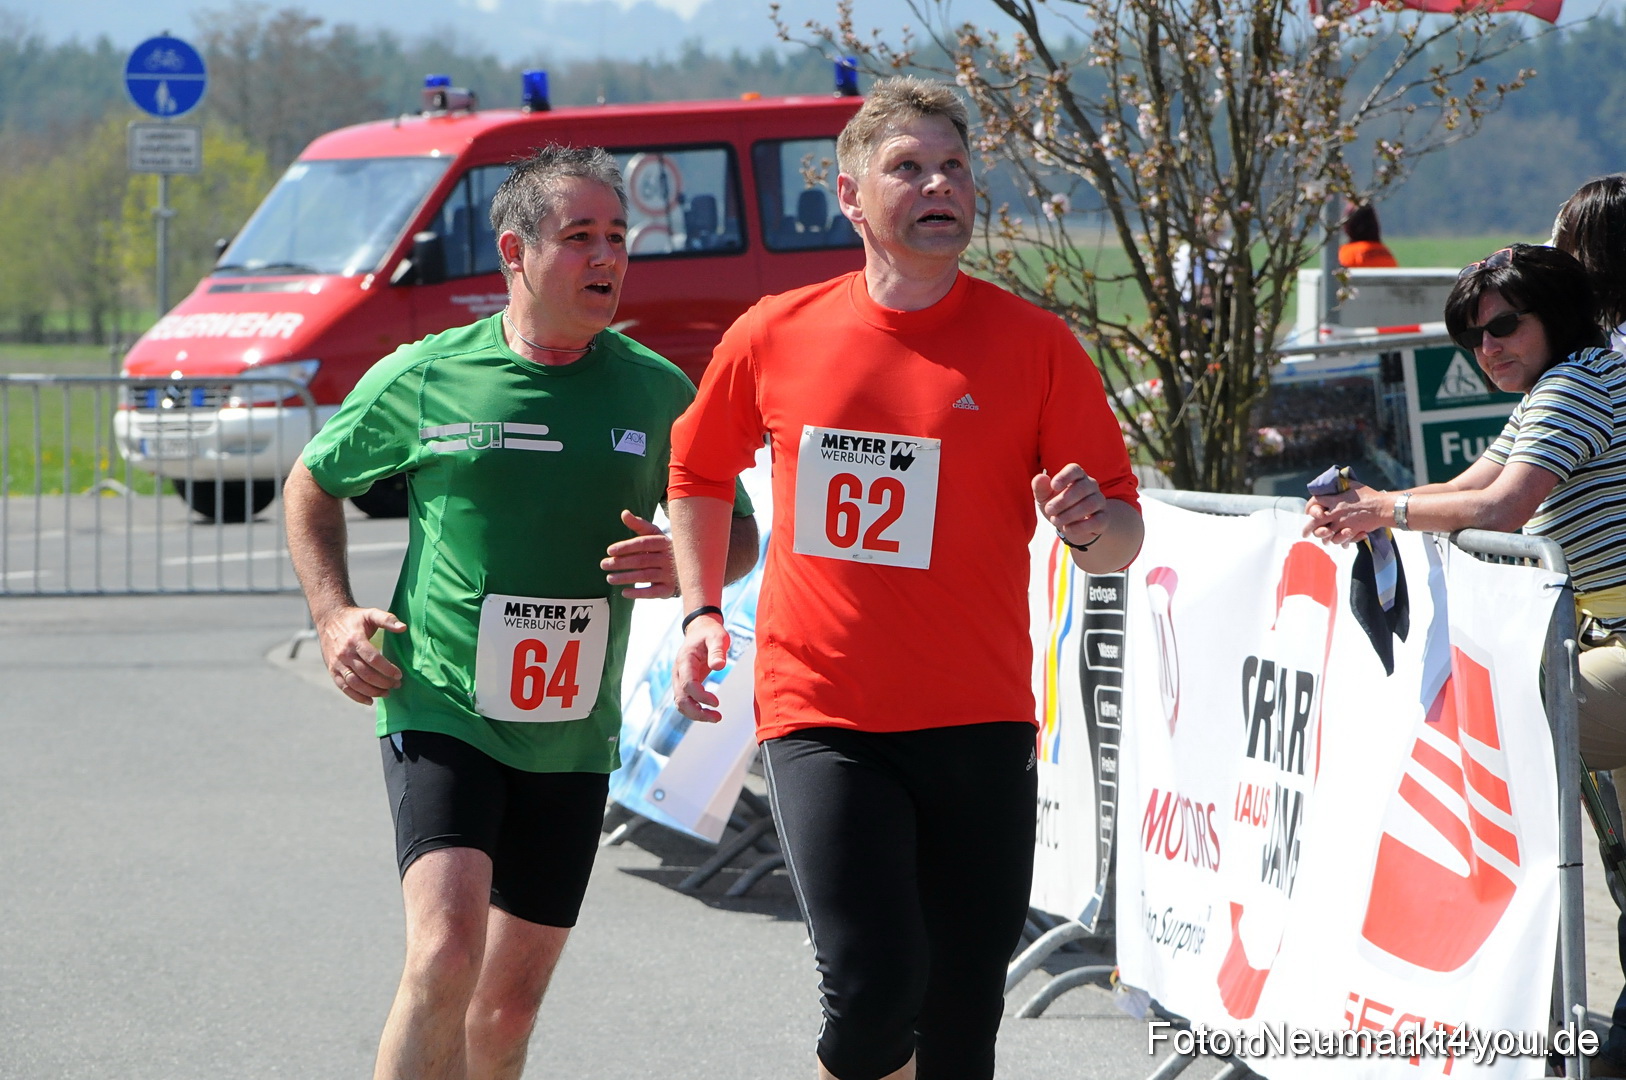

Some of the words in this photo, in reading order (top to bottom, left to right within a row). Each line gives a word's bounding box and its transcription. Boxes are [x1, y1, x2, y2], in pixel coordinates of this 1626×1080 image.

[149, 312, 304, 341] EUERWEHR
[821, 433, 887, 455] MEYER
[821, 449, 885, 466] WERBUNG
[825, 472, 906, 553] 62
[1089, 585, 1117, 603] Erdgas
[503, 602, 566, 620] MEYER
[503, 617, 566, 631] WERBUNG
[510, 638, 581, 711] 64
[1140, 788, 1220, 873] MOTORS
